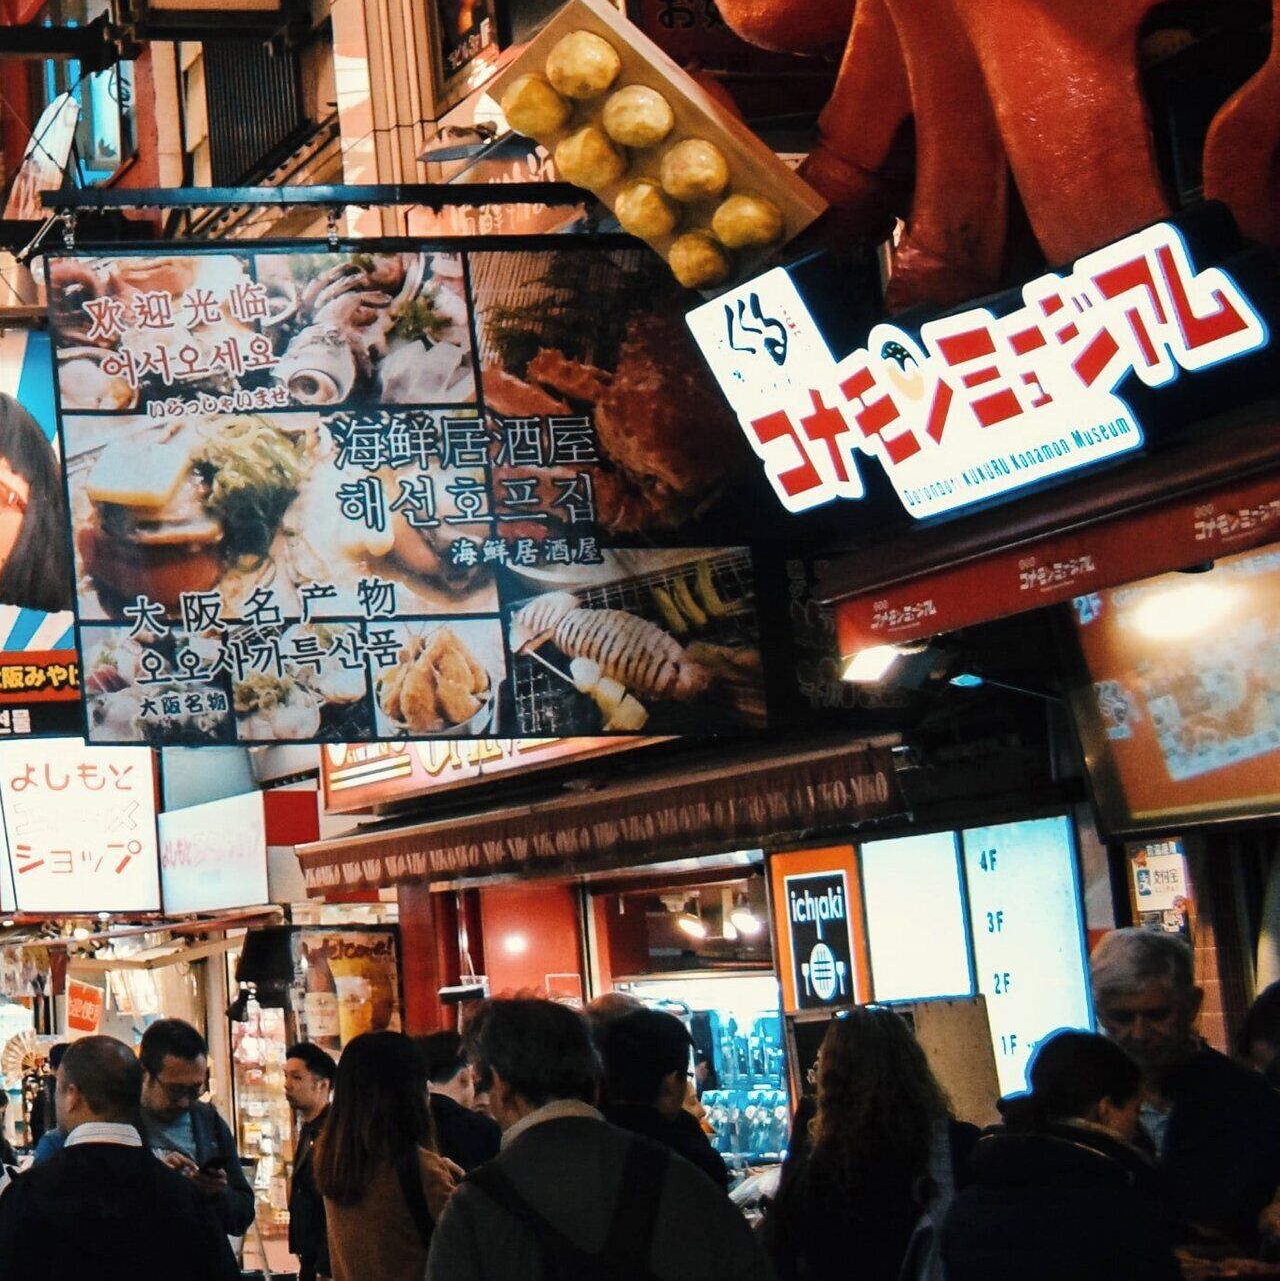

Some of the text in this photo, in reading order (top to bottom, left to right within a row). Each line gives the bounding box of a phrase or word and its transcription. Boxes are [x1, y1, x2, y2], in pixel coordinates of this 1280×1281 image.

[83, 282, 270, 338] 欢迎光临
[102, 335, 280, 387] 어서오세요
[148, 386, 290, 419] いらっしゃいませ
[336, 472, 596, 531] 해선호프집
[124, 577, 397, 638] 大阪名产物
[135, 628, 404, 685] 오오사까특산품
[140, 691, 228, 717] 大阪名物
[10, 763, 133, 792] よしもと
[16, 840, 143, 874] ショップ
